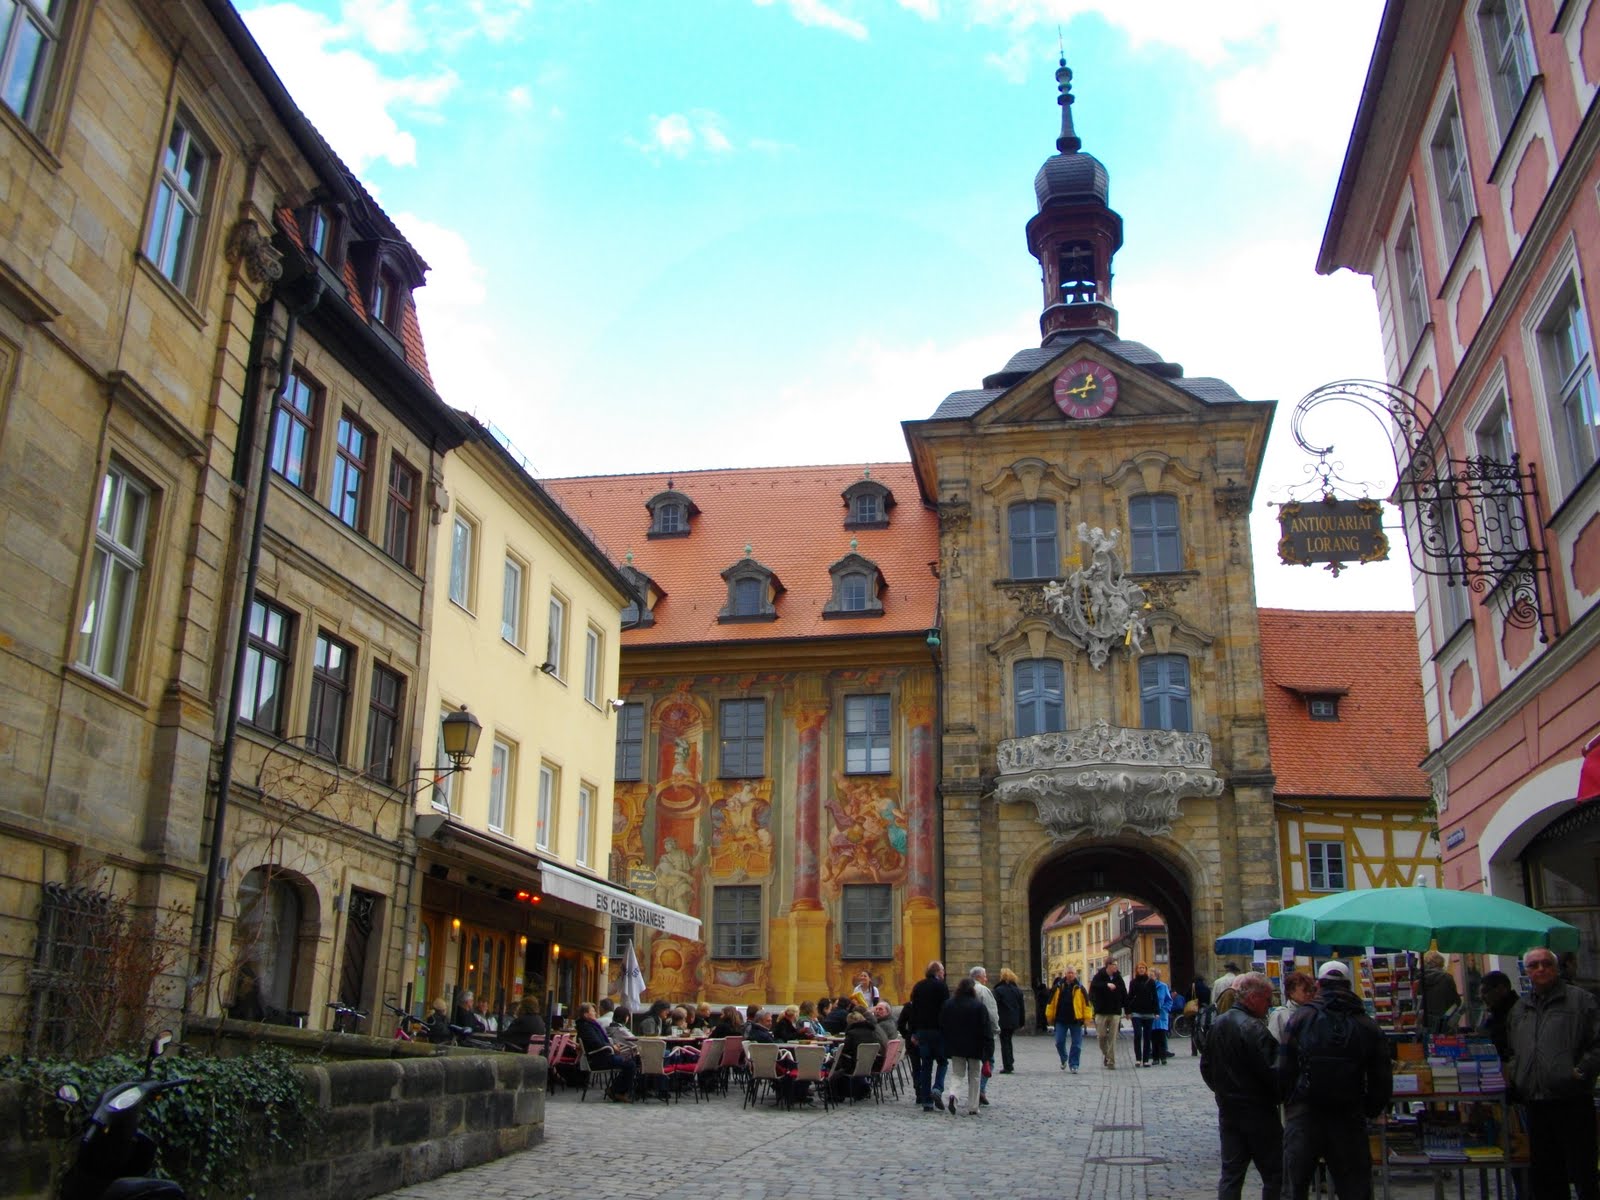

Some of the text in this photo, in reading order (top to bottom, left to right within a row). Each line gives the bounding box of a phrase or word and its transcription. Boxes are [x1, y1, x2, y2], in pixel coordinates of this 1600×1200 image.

[1291, 515, 1372, 535] ANTIQUARIAT
[1306, 536, 1360, 553] LORANG
[596, 893, 665, 929] EIS CAFE BASSANESE
